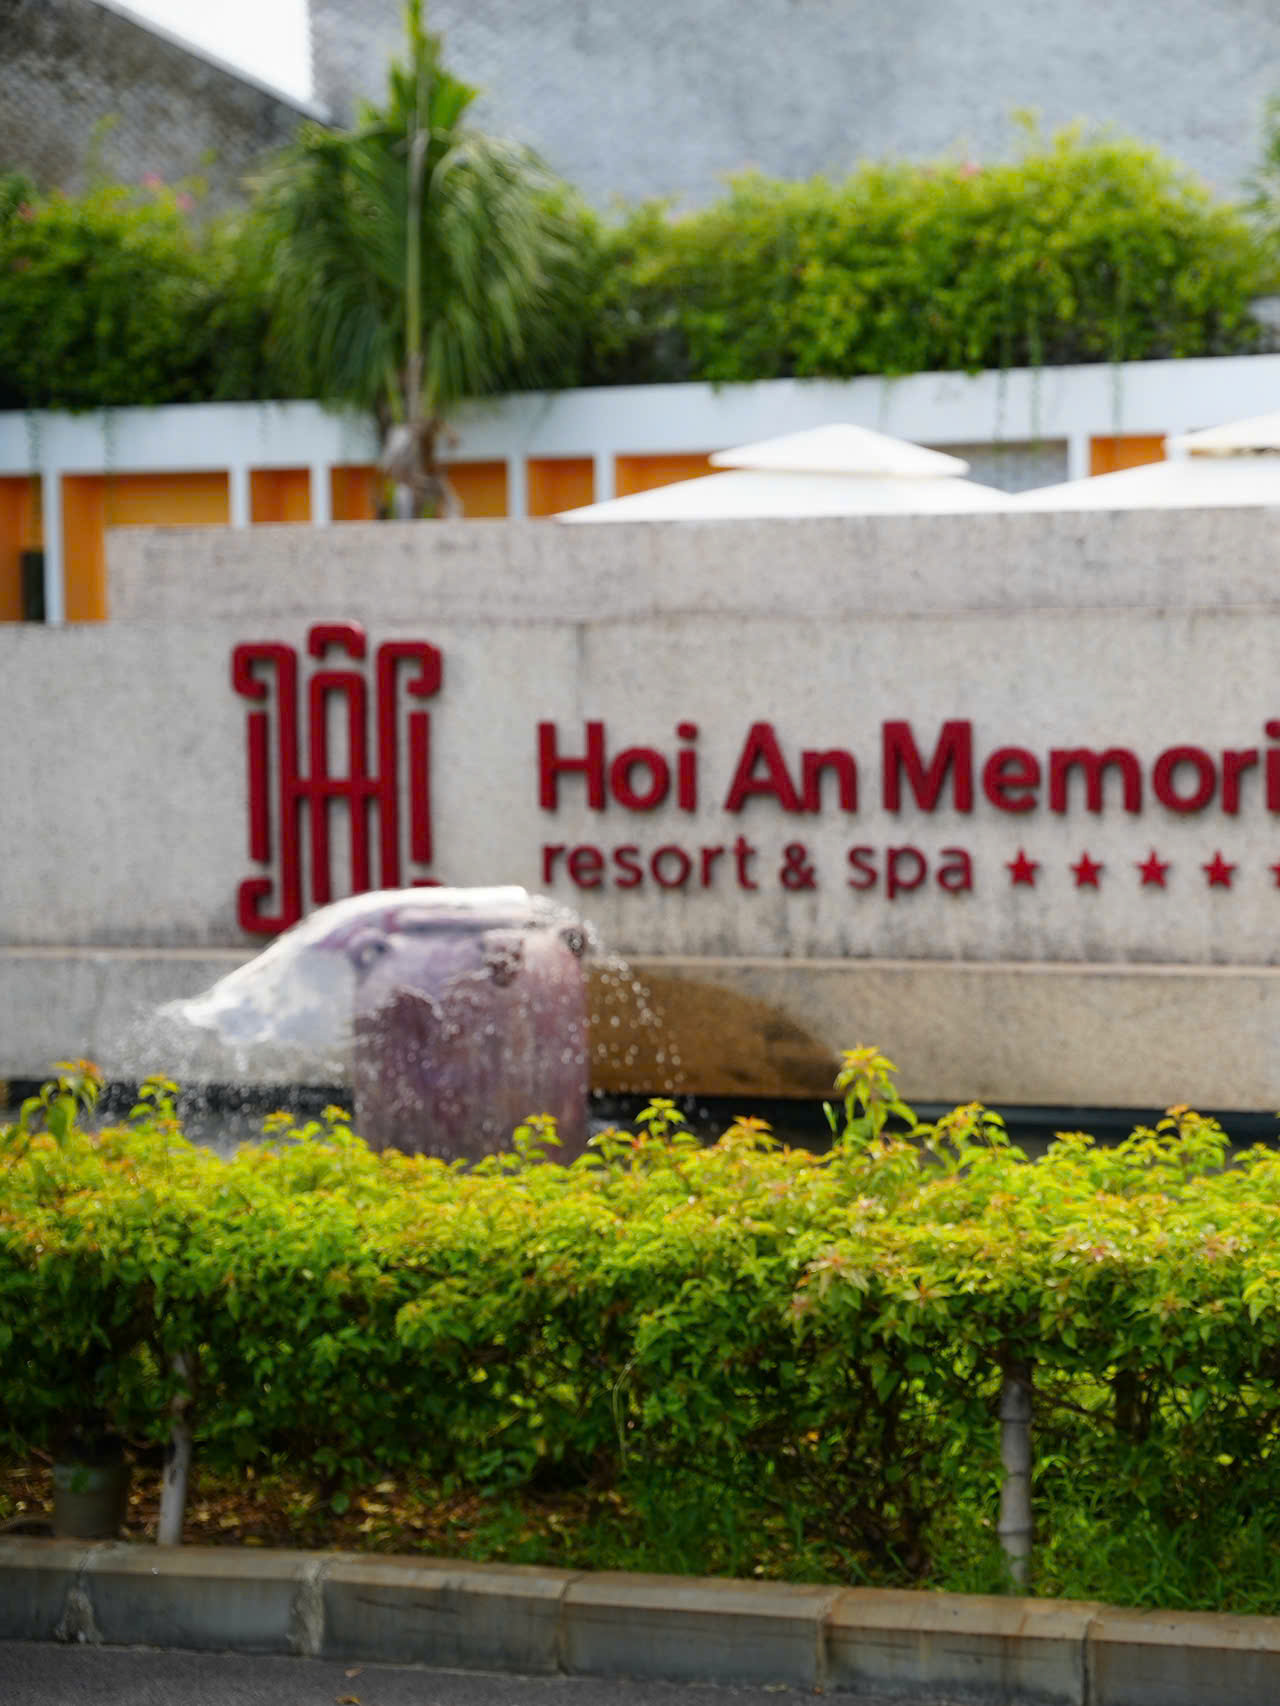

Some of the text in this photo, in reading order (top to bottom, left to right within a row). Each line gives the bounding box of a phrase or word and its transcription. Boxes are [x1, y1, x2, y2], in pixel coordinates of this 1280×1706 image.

[537, 721, 698, 813] Hoi
[724, 721, 859, 814] An
[542, 836, 974, 900] resort & spa
